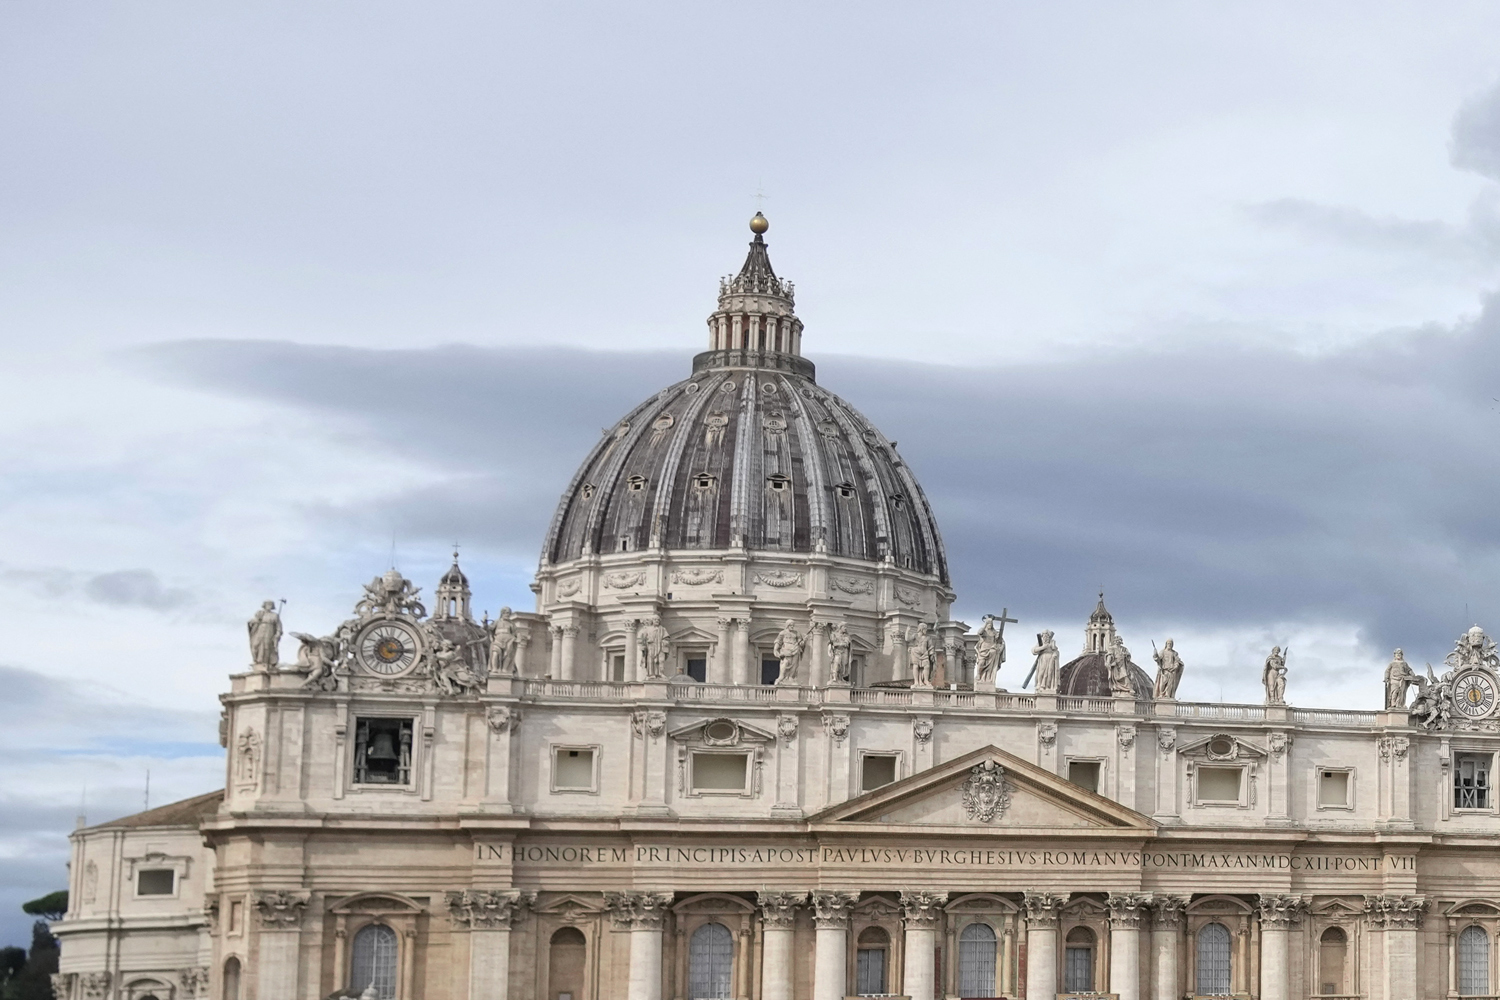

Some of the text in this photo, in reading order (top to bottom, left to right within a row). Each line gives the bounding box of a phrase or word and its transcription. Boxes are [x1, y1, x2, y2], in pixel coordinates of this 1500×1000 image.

[477, 845, 503, 860] IN
[512, 846, 627, 862] HONOREM
[636, 847, 747, 863] PRINCIPIS
[751, 848, 818, 863] APOST
[1043, 851, 1140, 866] ROMANVS
[1390, 857, 1414, 870] VII
